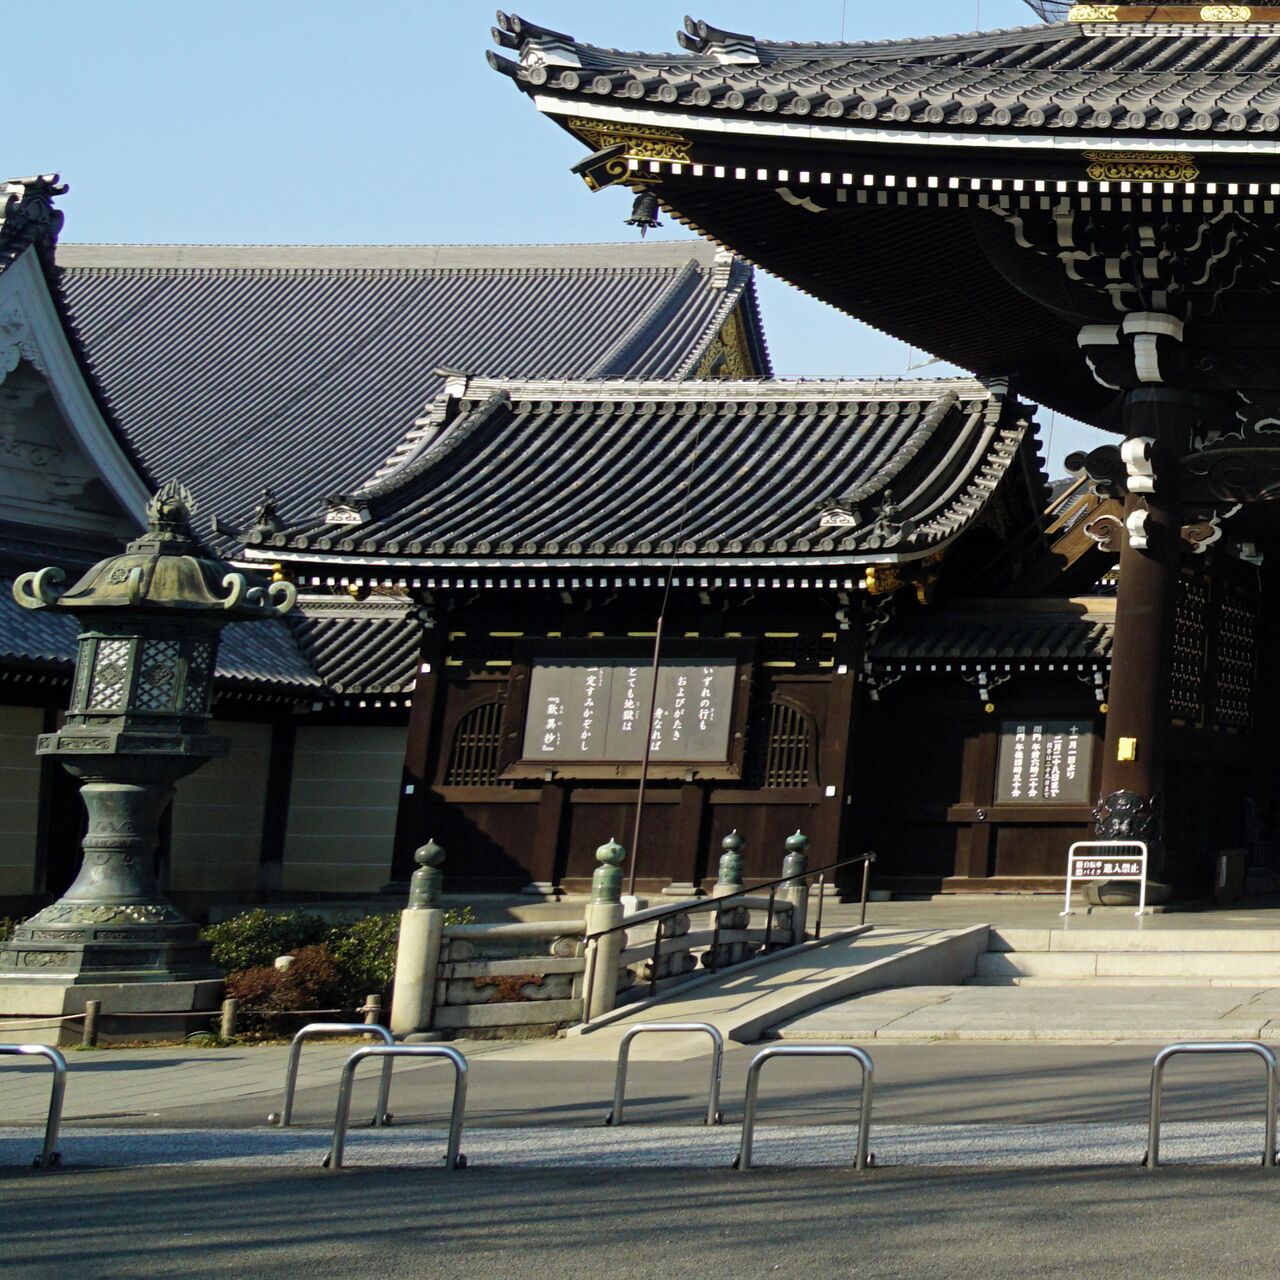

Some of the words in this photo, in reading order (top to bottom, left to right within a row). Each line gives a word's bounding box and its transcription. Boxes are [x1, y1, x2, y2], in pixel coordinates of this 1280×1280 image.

[580, 667, 599, 751] 一定すみかぞかし
[622, 667, 637, 731] とても地獄は
[651, 707, 664, 750] 身なれば
[673, 676, 687, 740] およびがたき
[699, 667, 713, 730] いずれの行も
[1103, 862, 1139, 873] 進入禁止
